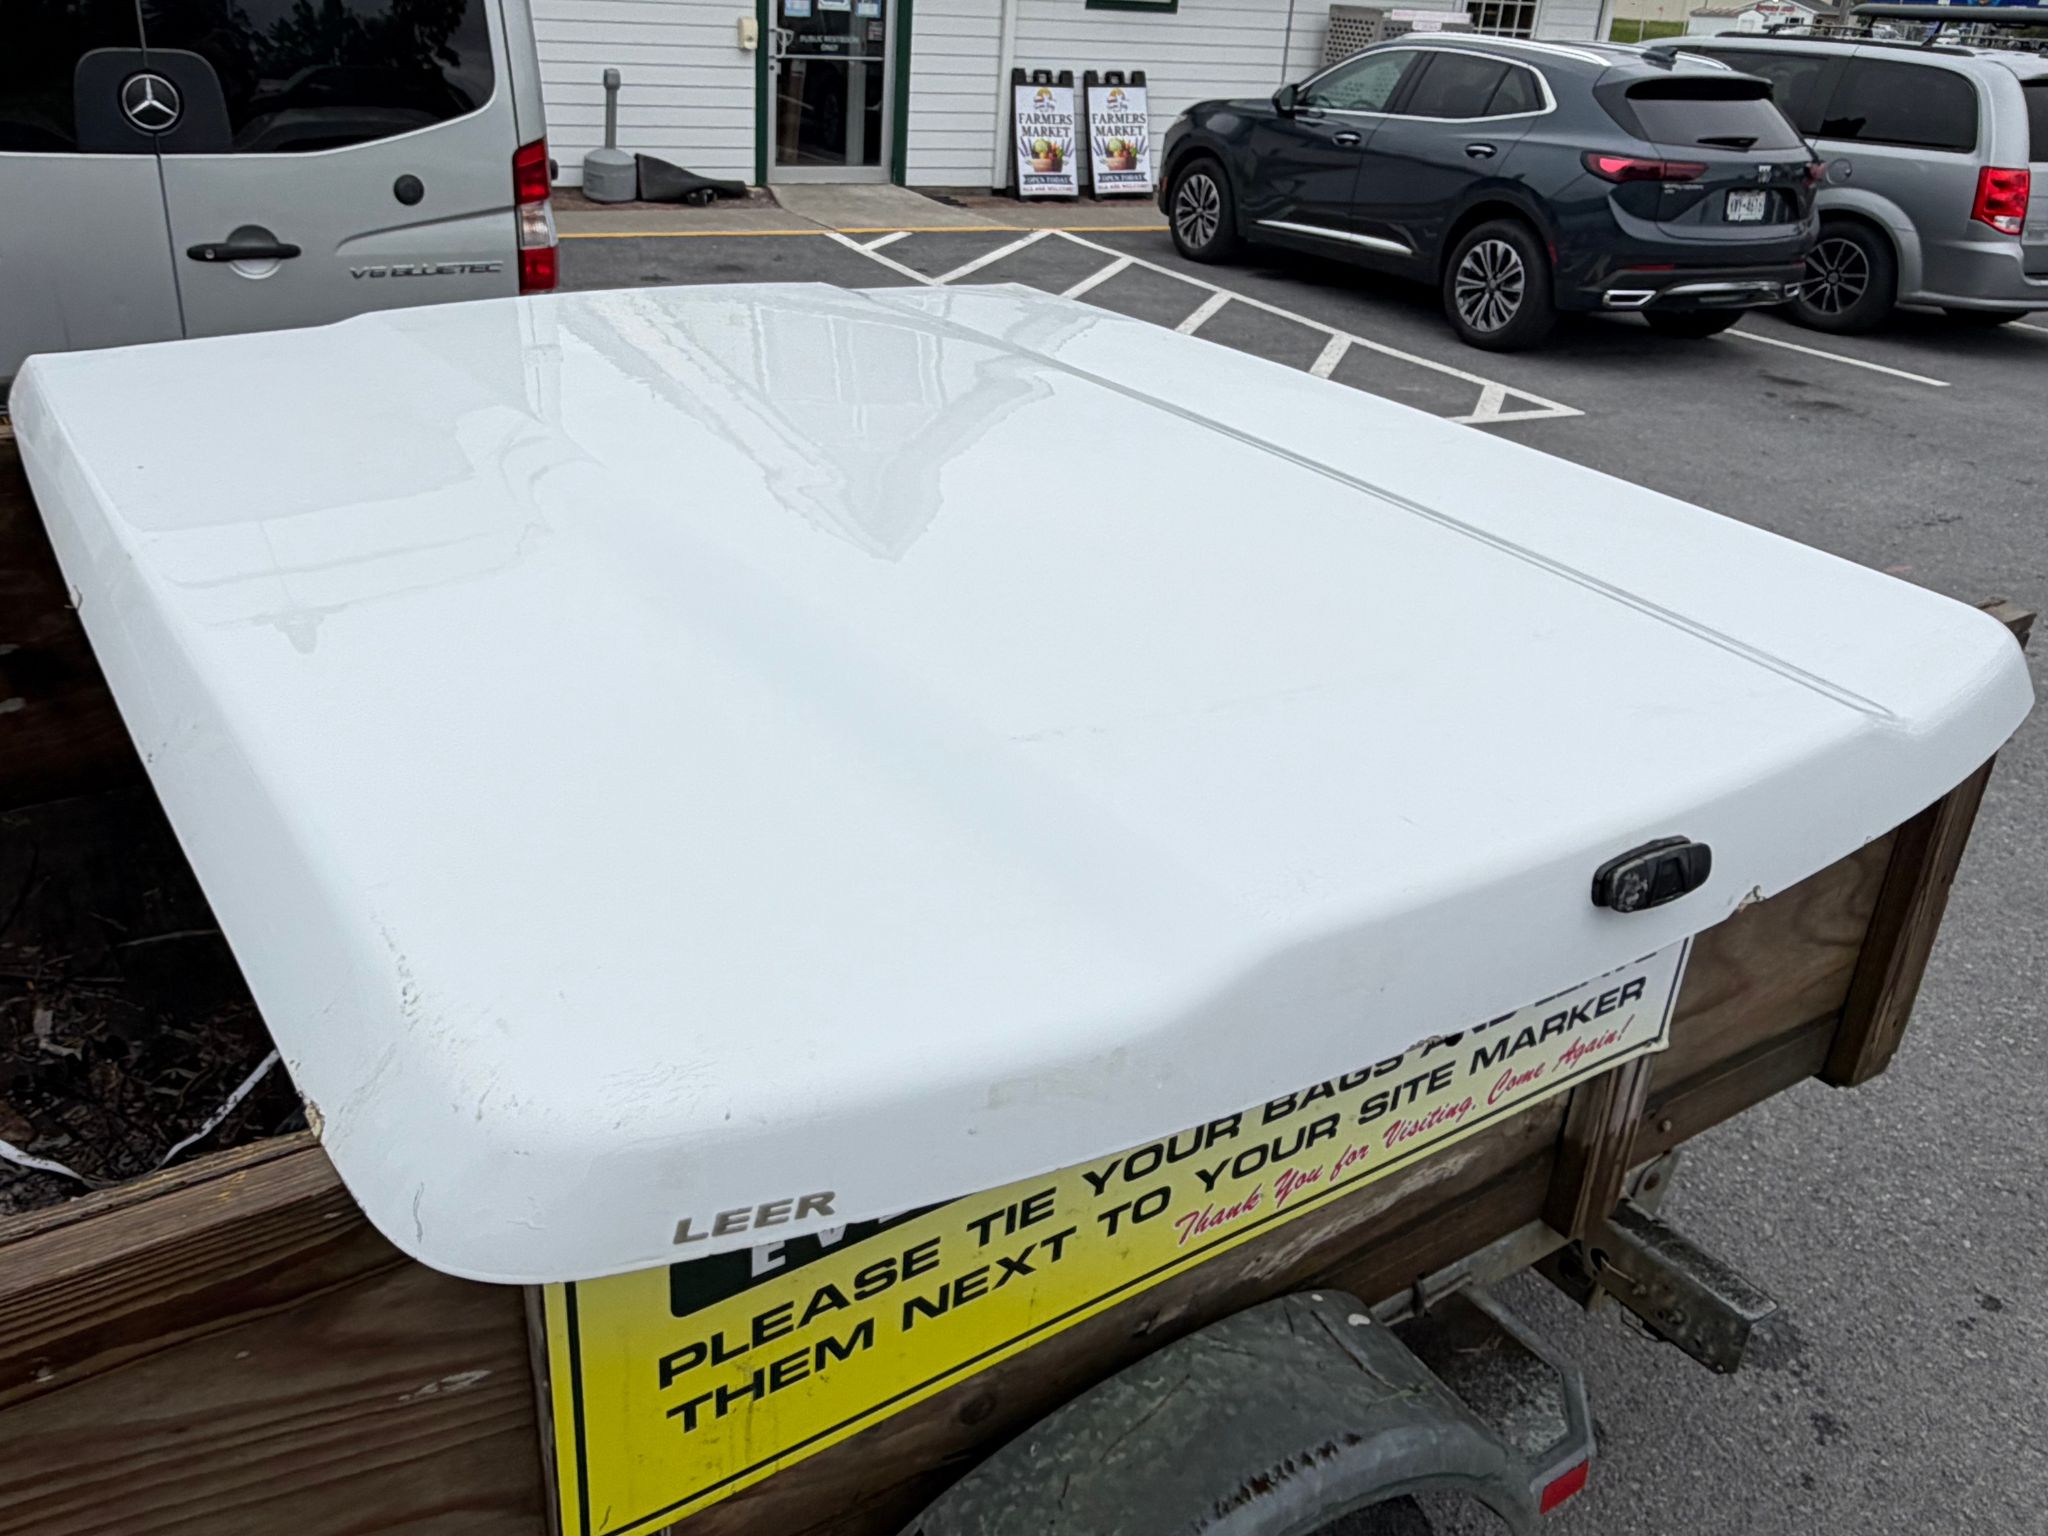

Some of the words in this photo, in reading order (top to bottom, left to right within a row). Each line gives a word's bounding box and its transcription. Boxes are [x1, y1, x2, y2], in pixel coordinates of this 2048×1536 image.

[1018, 113, 1073, 125] FARMERS
[1092, 113, 1146, 125] FARMERS
[1022, 126, 1071, 138] MARKET
[1095, 125, 1144, 137] MARKET
[349, 265, 387, 279] V6
[391, 260, 504, 277] BLUETEC
[1175, 1183, 1263, 1246] Thank
[1274, 1167, 1324, 1209] You
[1329, 1144, 1369, 1182] for
[1487, 1063, 1546, 1105] Come
[1552, 1013, 1636, 1073] Again!
[666, 1317, 875, 1434] THEM
[902, 1225, 1077, 1332] NEXT
[1097, 1185, 1171, 1237] TO
[1195, 1112, 1341, 1193] YOUR
[1358, 1060, 1456, 1125] SITE
[1469, 976, 1647, 1076] MARKER
[659, 1236, 942, 1391] PLEASE
[966, 1186, 1057, 1248] TIE
[1082, 1112, 1243, 1197] YOUR
[1262, 1054, 1404, 1126] BAGS
[673, 1191, 836, 1245] LEER
